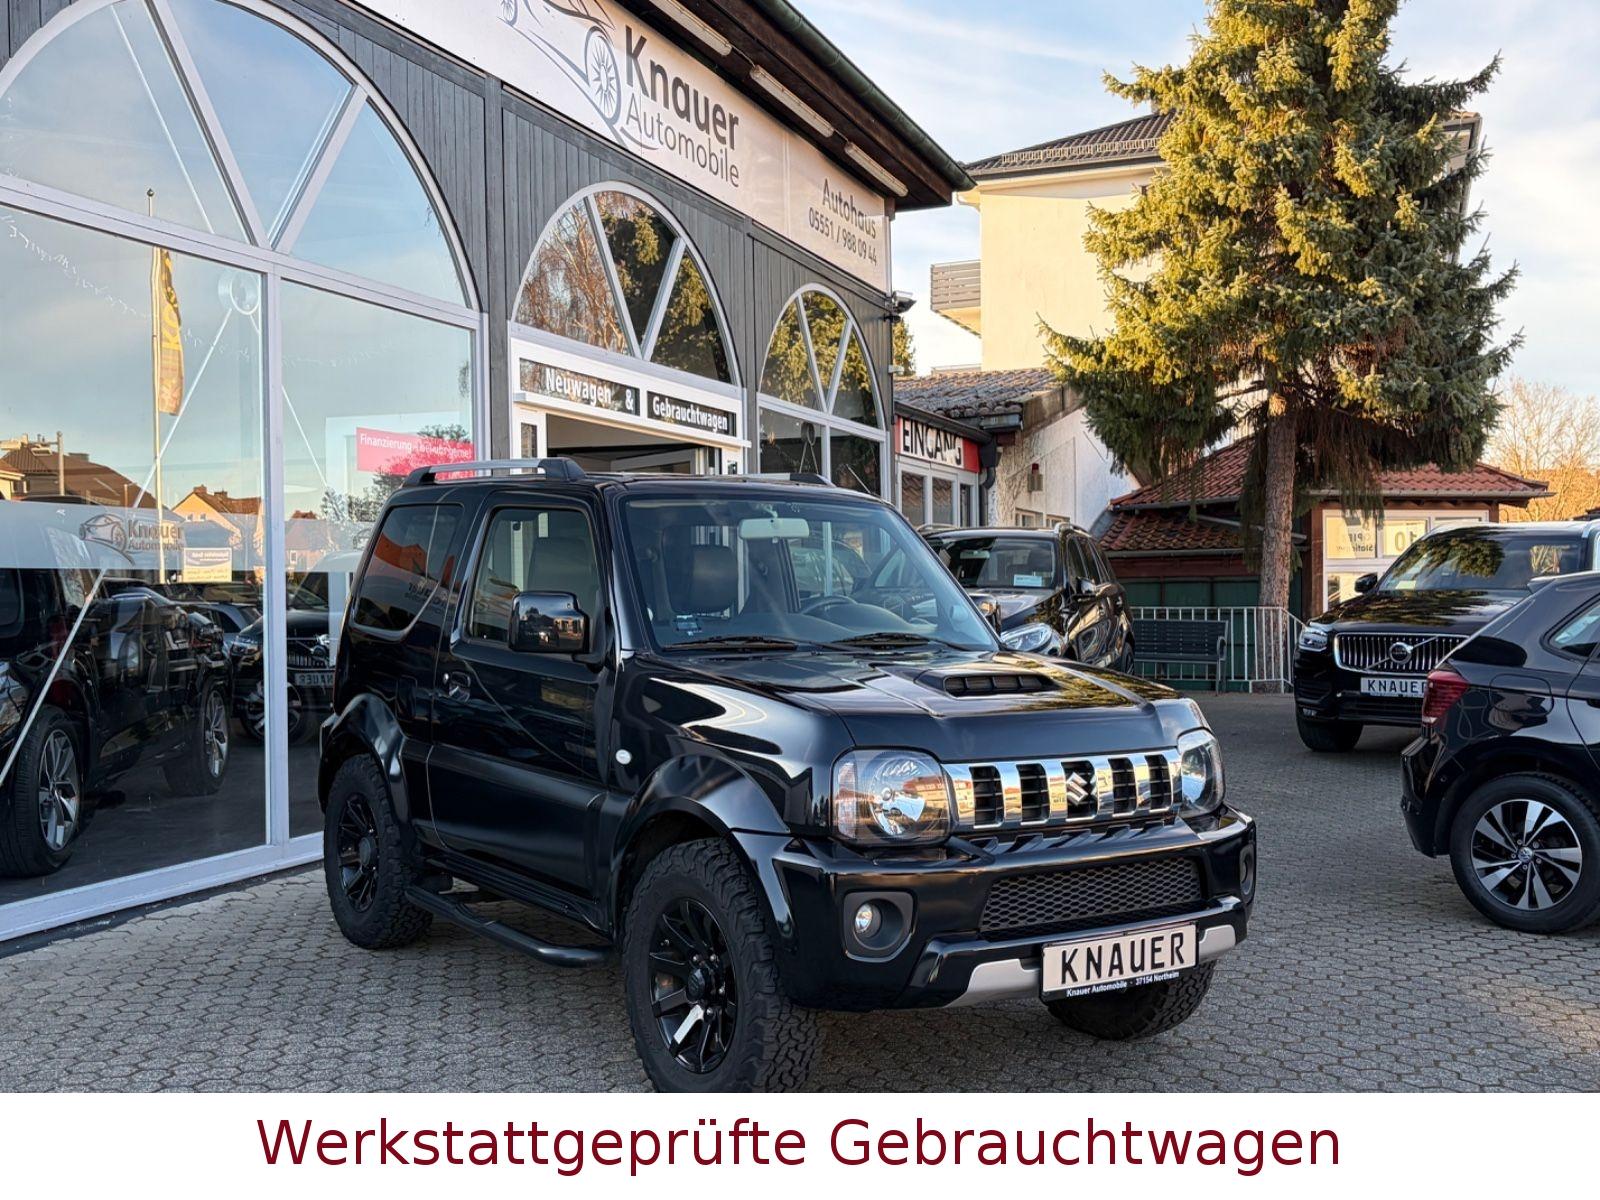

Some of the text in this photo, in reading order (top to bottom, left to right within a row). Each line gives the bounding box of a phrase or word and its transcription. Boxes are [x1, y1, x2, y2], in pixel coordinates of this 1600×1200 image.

[625, 25, 739, 151] Knauer
[626, 93, 739, 188] Automobile
[822, 178, 876, 239] Autohaus
[808, 206, 834, 240] 05551
[842, 228, 857, 254] 988
[857, 238, 867, 259] 09
[868, 245, 877, 266] 44
[546, 367, 634, 411] Neuwagen &
[652, 396, 728, 433] Gebrauchtwagen
[128, 520, 182, 539] Knauer
[128, 539, 184, 551] Automobile
[1061, 932, 1185, 985] KNAUER
[1066, 972, 1180, 998] Knauer Automobile 37154 Northeim
